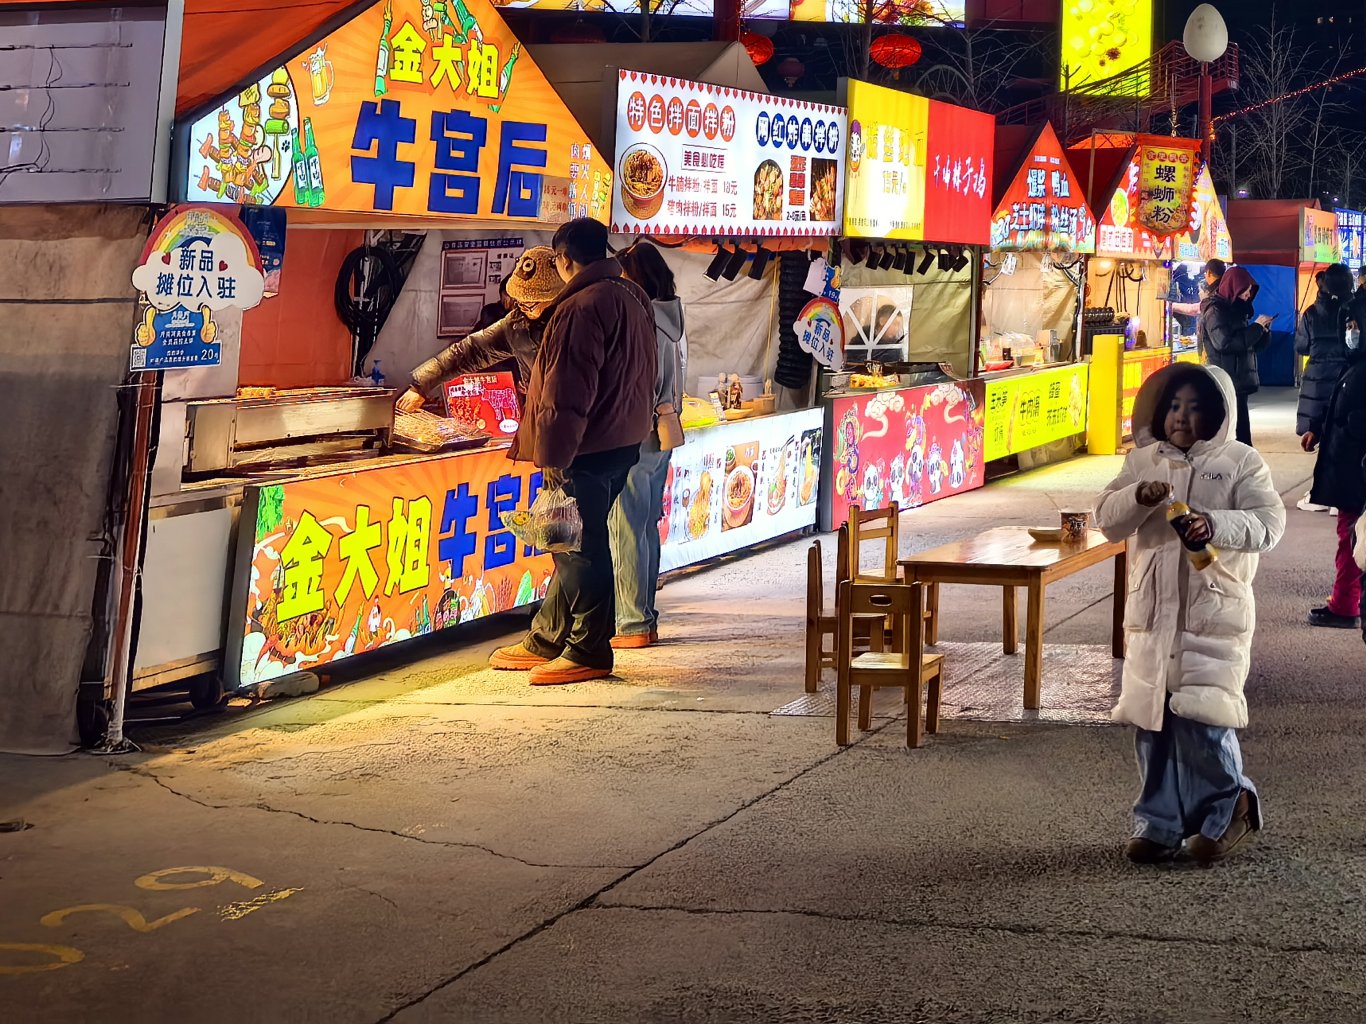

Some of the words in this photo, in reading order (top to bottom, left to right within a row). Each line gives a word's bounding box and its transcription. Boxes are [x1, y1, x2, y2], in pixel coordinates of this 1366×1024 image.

[389, 20, 500, 100] 金大姐
[628, 94, 736, 139] 特色拌面拌粉
[350, 98, 548, 217] 牛宫后
[1151, 164, 1176, 224] 螺蛳粉
[155, 271, 236, 299] 摊位入驻
[179, 247, 214, 272] 新品
[276, 495, 432, 624] 金大姐
